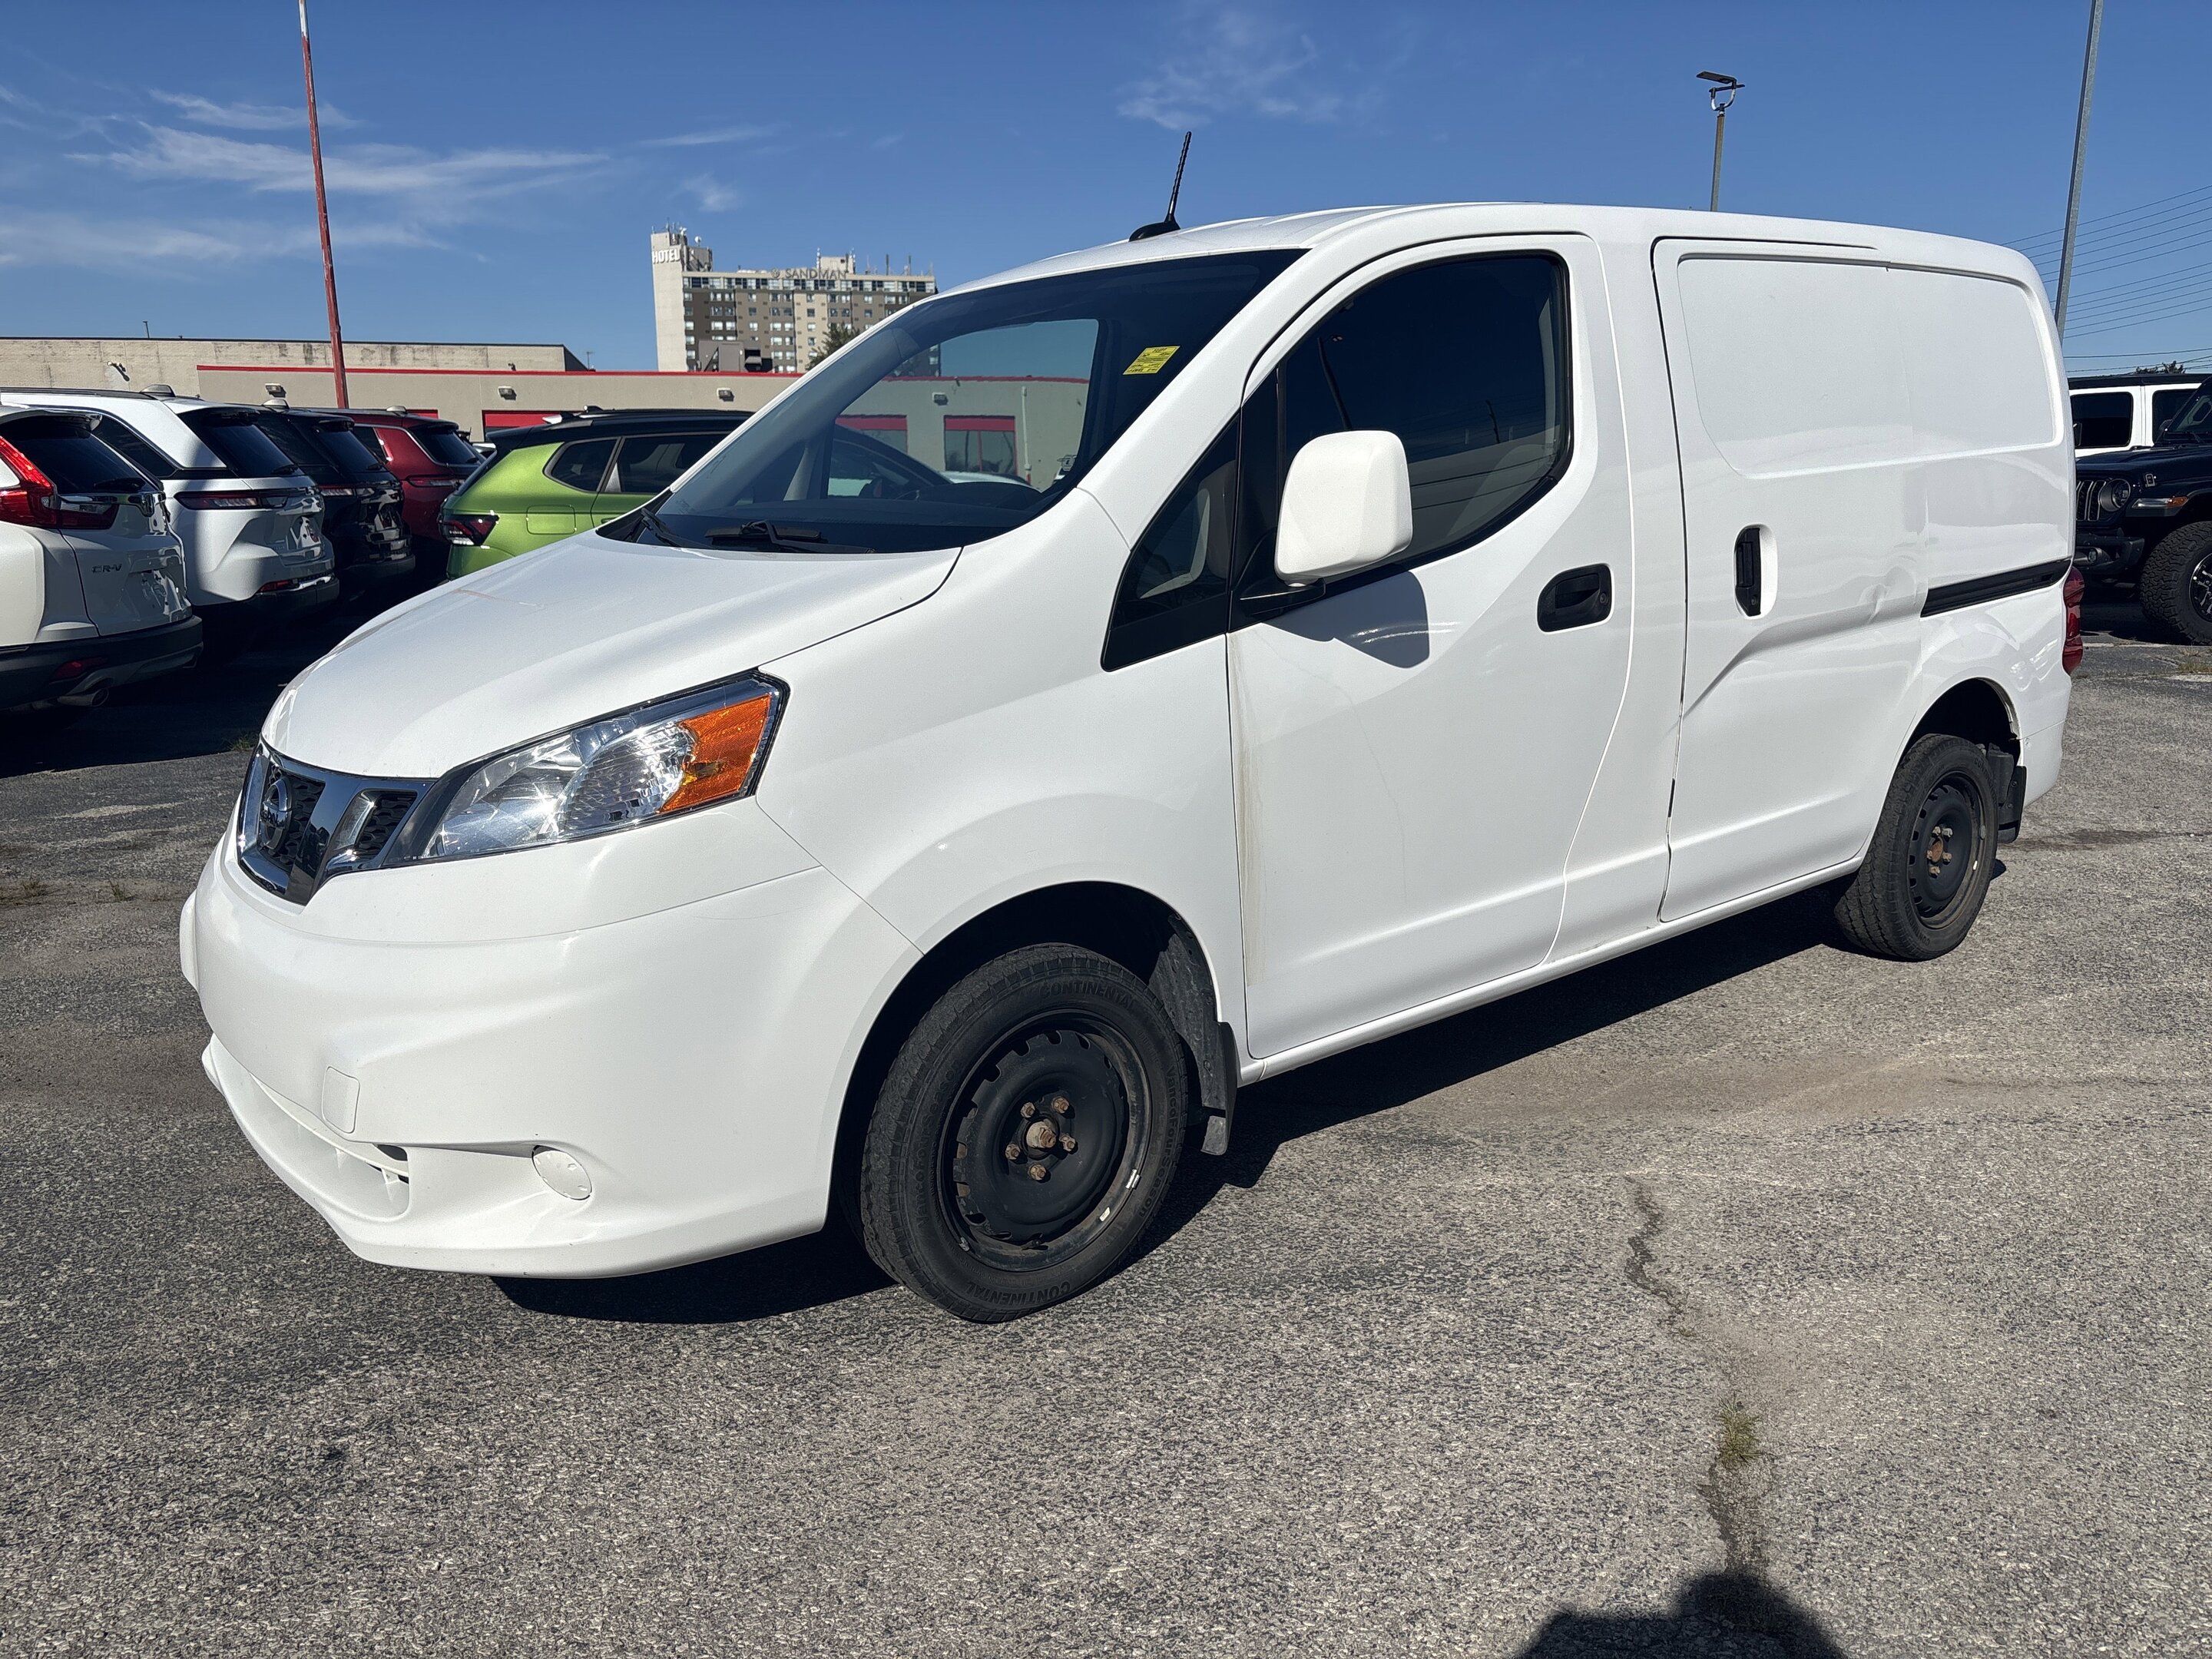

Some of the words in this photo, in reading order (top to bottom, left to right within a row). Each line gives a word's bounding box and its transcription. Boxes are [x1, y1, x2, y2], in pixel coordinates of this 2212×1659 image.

[651, 248, 680, 263] HOTEL
[785, 267, 846, 280] SANDMAN
[91, 563, 123, 573] CR-V
[1039, 980, 1137, 1008] CONTINENTAL
[965, 1281, 1072, 1307] CONTINENTAL
